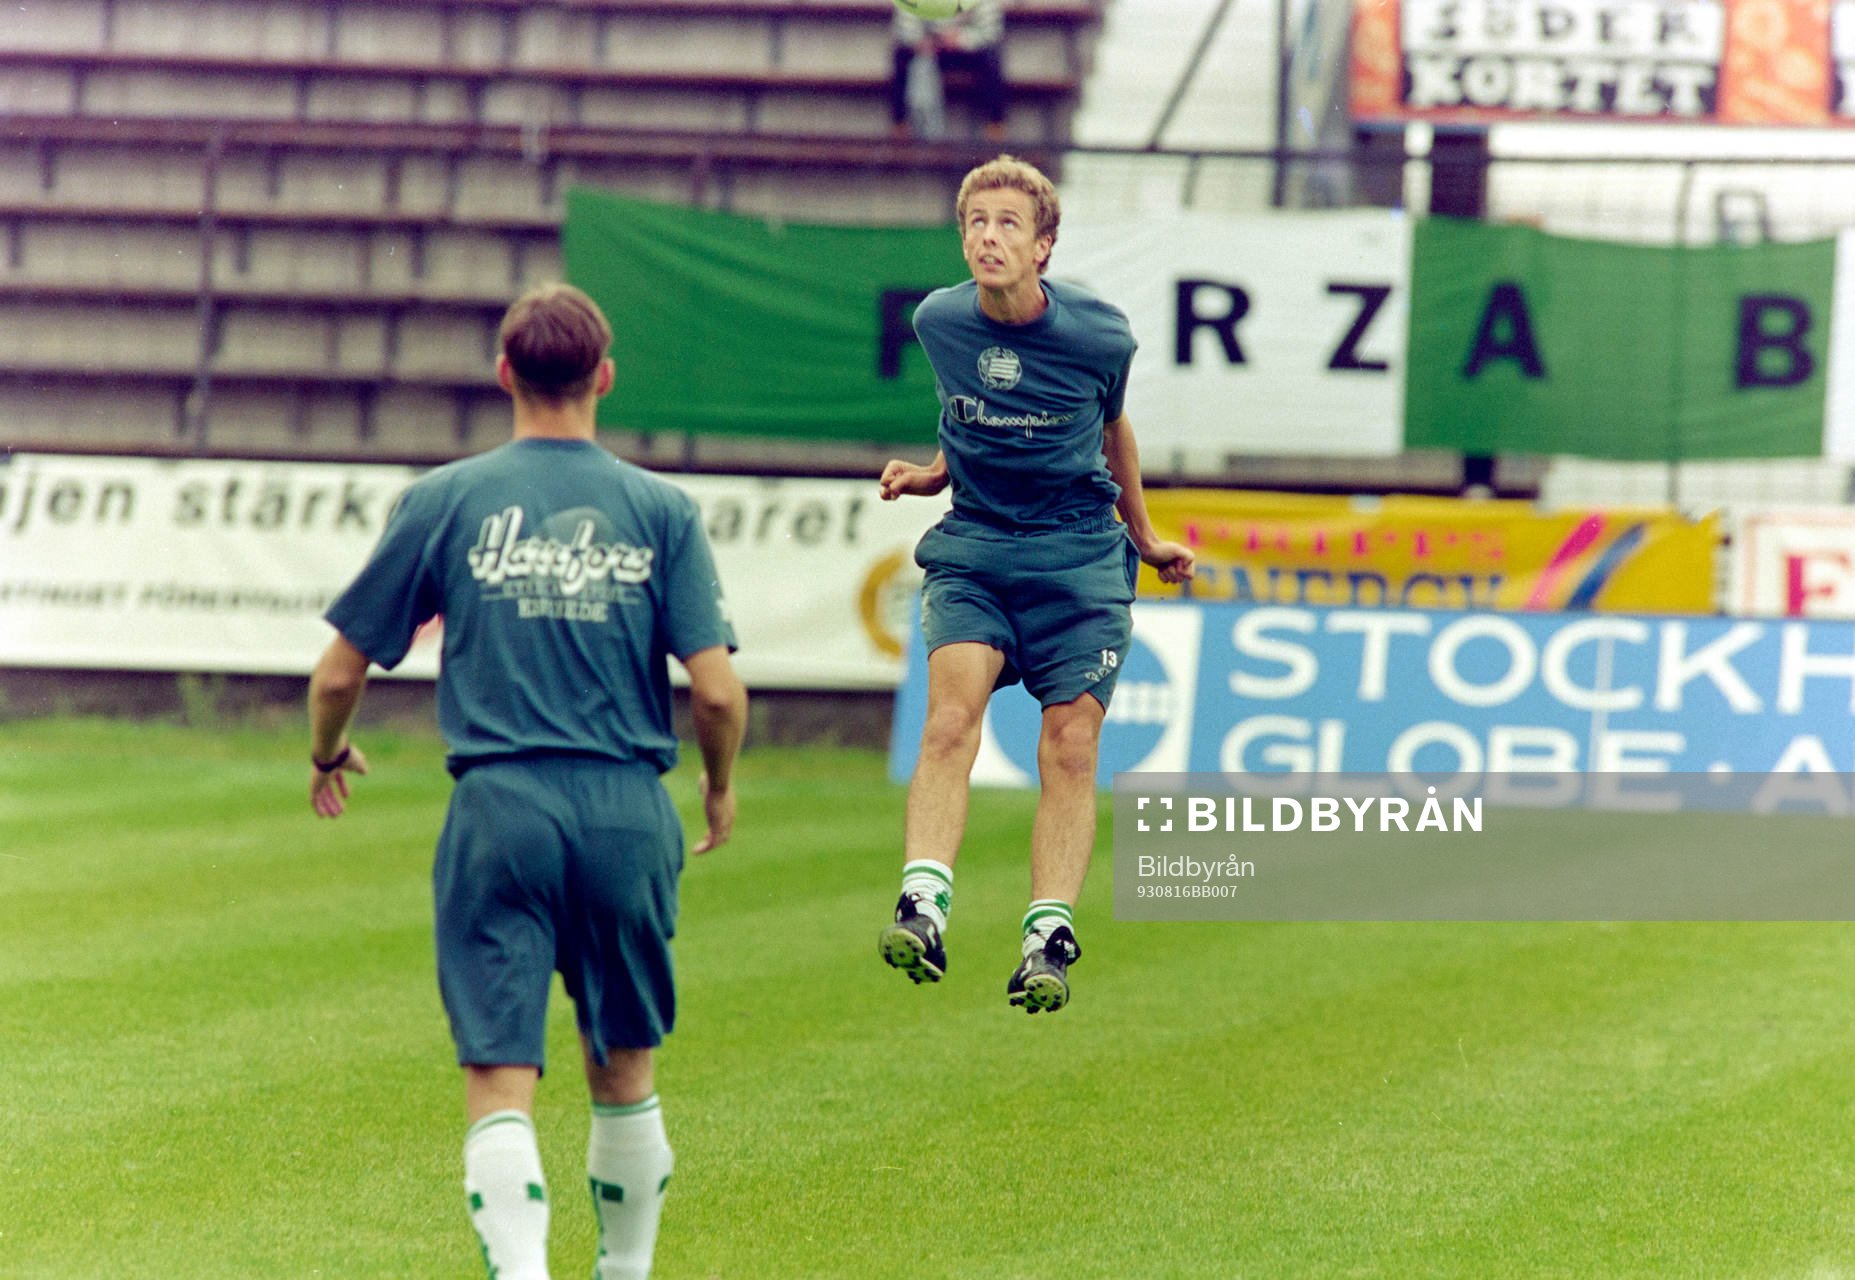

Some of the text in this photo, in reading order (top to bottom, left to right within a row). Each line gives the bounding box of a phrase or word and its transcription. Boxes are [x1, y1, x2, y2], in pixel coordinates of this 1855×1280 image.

[1408, 55, 1716, 115] KORTET
[0, 470, 390, 537] jen stärk
[706, 492, 868, 547] aret
[1101, 649, 1118, 668] 13
[1228, 609, 1855, 714] STOCKH
[1219, 714, 1688, 813] GLOBE
